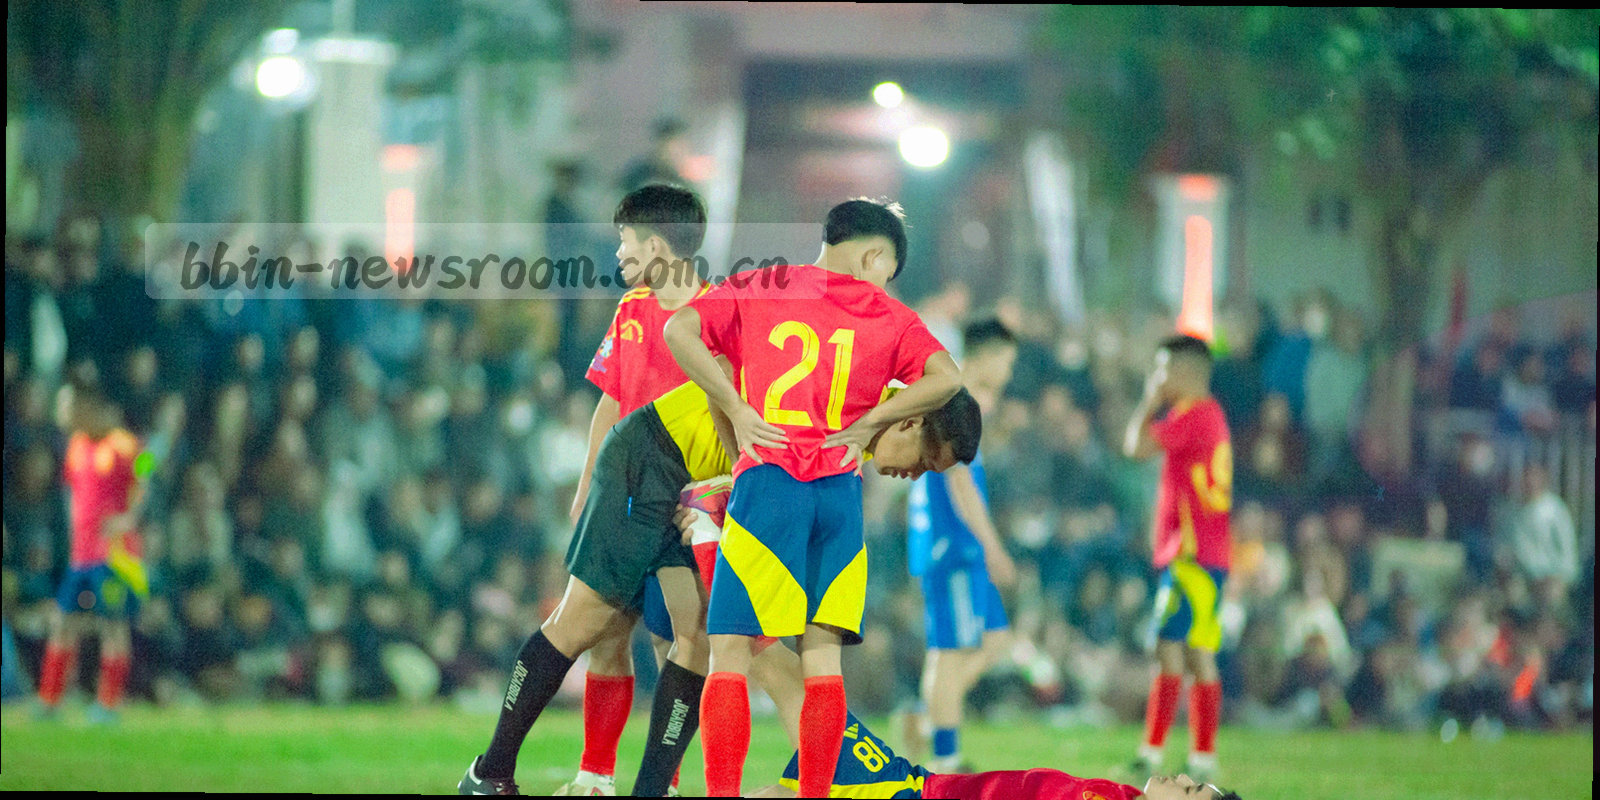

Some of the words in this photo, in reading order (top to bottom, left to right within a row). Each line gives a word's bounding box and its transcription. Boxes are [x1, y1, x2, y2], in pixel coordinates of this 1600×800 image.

[764, 320, 855, 430] 21
[661, 698, 689, 745] JOGARBOLA
[853, 736, 890, 772] 18
